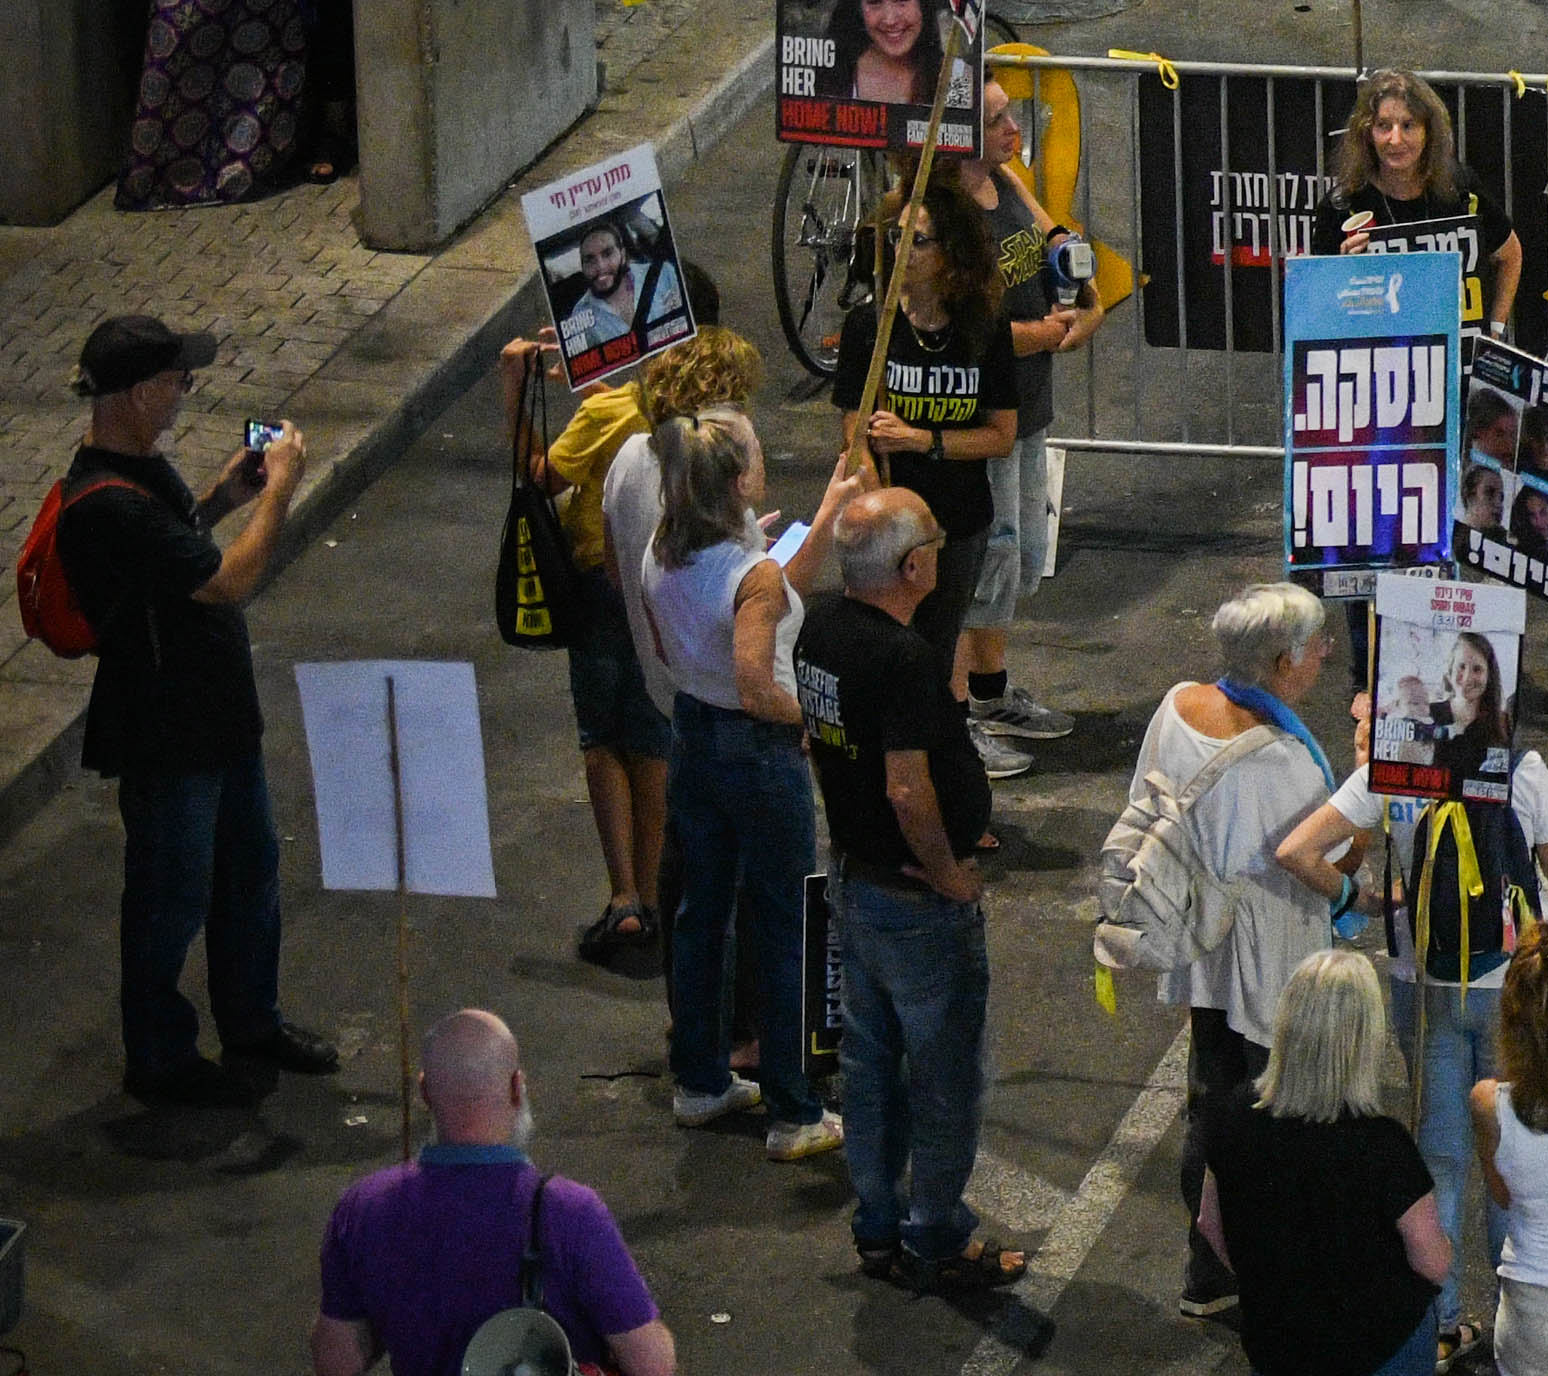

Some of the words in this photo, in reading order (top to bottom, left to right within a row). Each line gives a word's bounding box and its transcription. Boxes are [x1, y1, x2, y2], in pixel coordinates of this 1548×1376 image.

[782, 35, 836, 69] BRING
[782, 66, 816, 97] HER
[1294, 345, 1446, 442] עסקה.
[1293, 461, 1439, 547] היום!
[1375, 719, 1415, 741] BRING
[1374, 740, 1400, 761] HER
